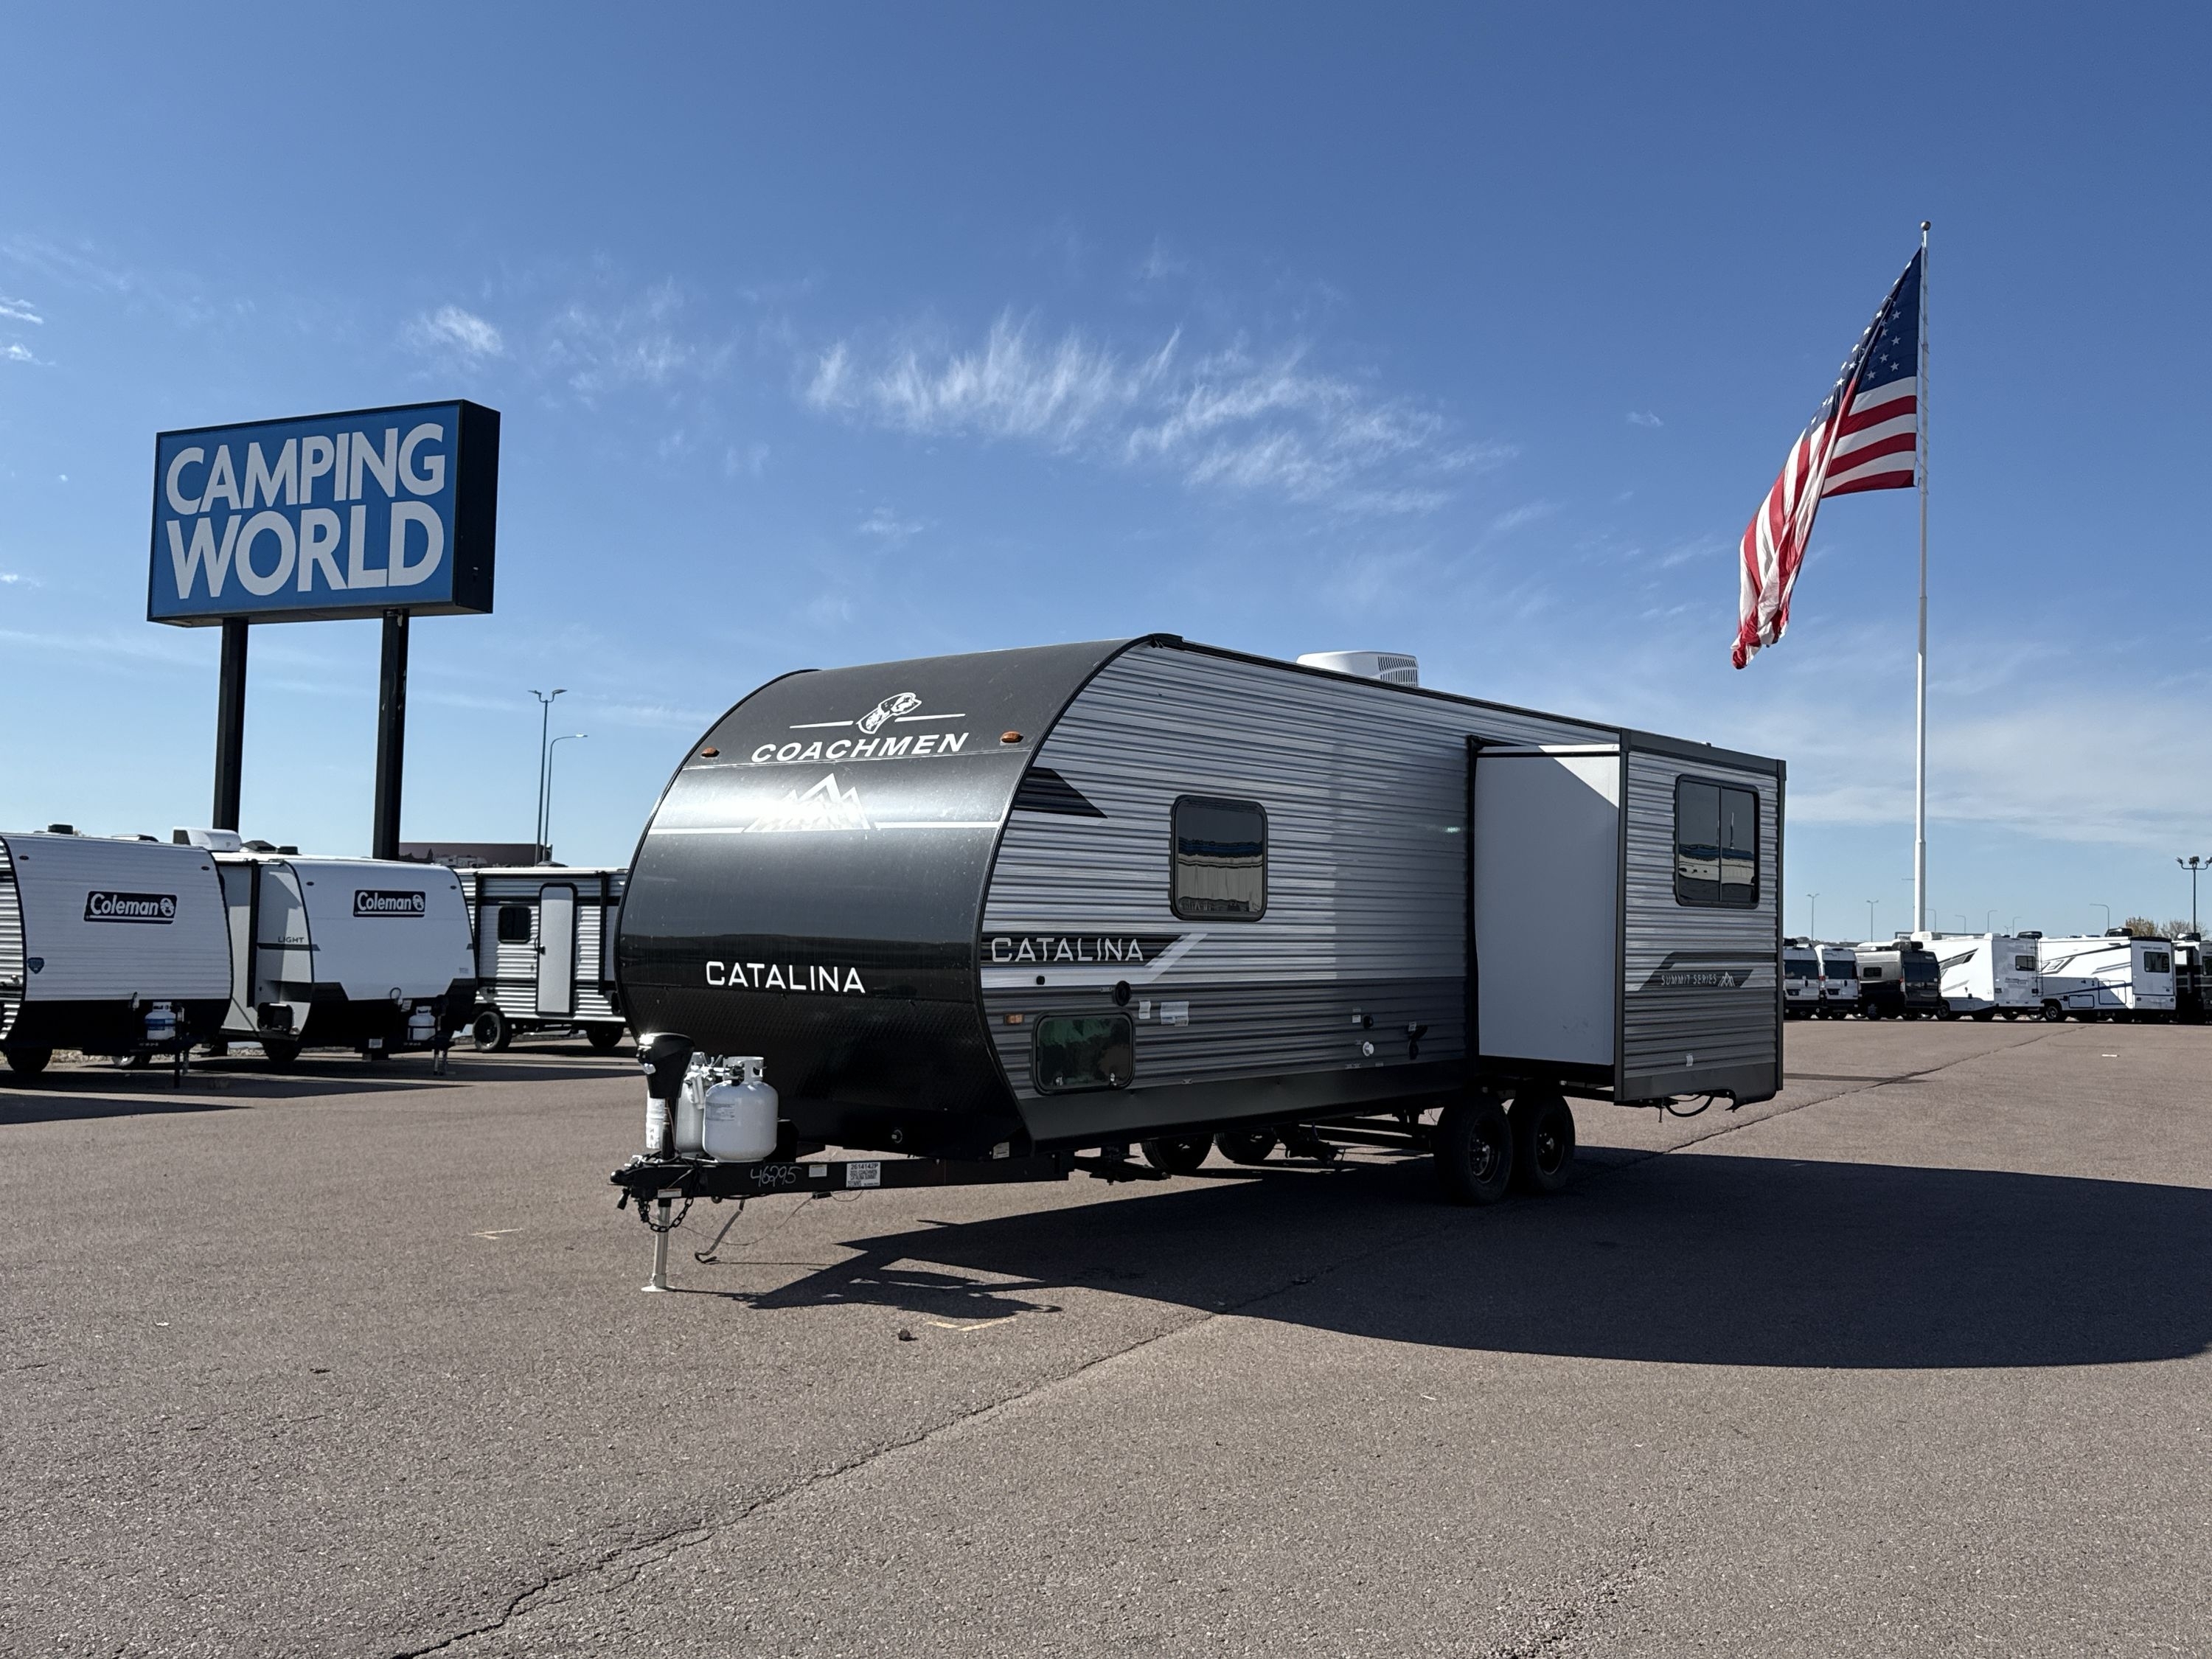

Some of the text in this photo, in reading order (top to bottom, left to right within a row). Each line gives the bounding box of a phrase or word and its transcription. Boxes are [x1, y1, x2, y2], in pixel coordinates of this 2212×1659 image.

[166, 422, 445, 515] CAMPING
[166, 500, 445, 599] WORLD
[751, 732, 970, 763] COACHMEN
[90, 893, 159, 916] Coleman
[357, 891, 411, 911] Coleman
[991, 937, 1144, 962] CATALINA
[706, 961, 866, 994] CATALINA
[1660, 973, 1717, 986] SUMMIT SERIES
